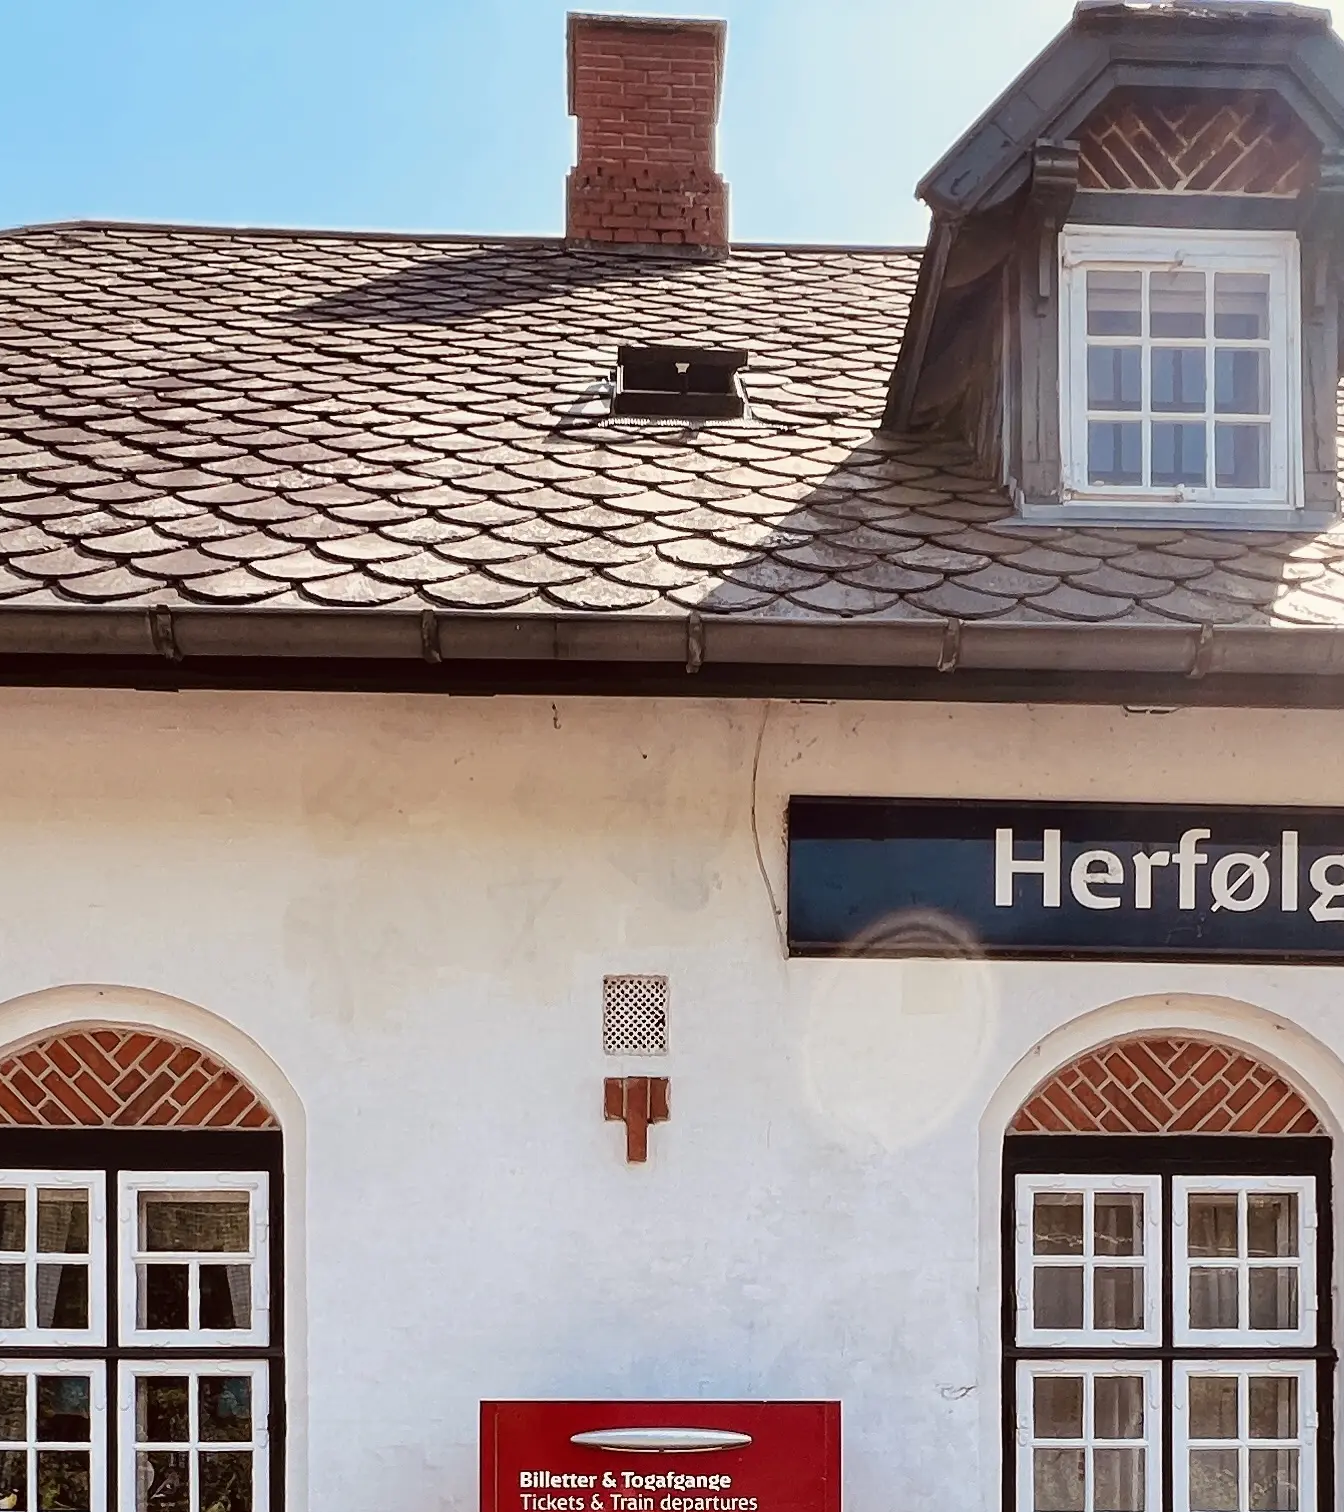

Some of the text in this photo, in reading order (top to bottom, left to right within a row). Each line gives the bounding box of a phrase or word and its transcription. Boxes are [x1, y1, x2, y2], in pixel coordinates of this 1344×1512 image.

[519, 1471, 733, 1492] Billetter & Togafgange
[519, 1493, 585, 1511] Tickets
[590, 1493, 605, 1511] &
[609, 1493, 654, 1511] Train
